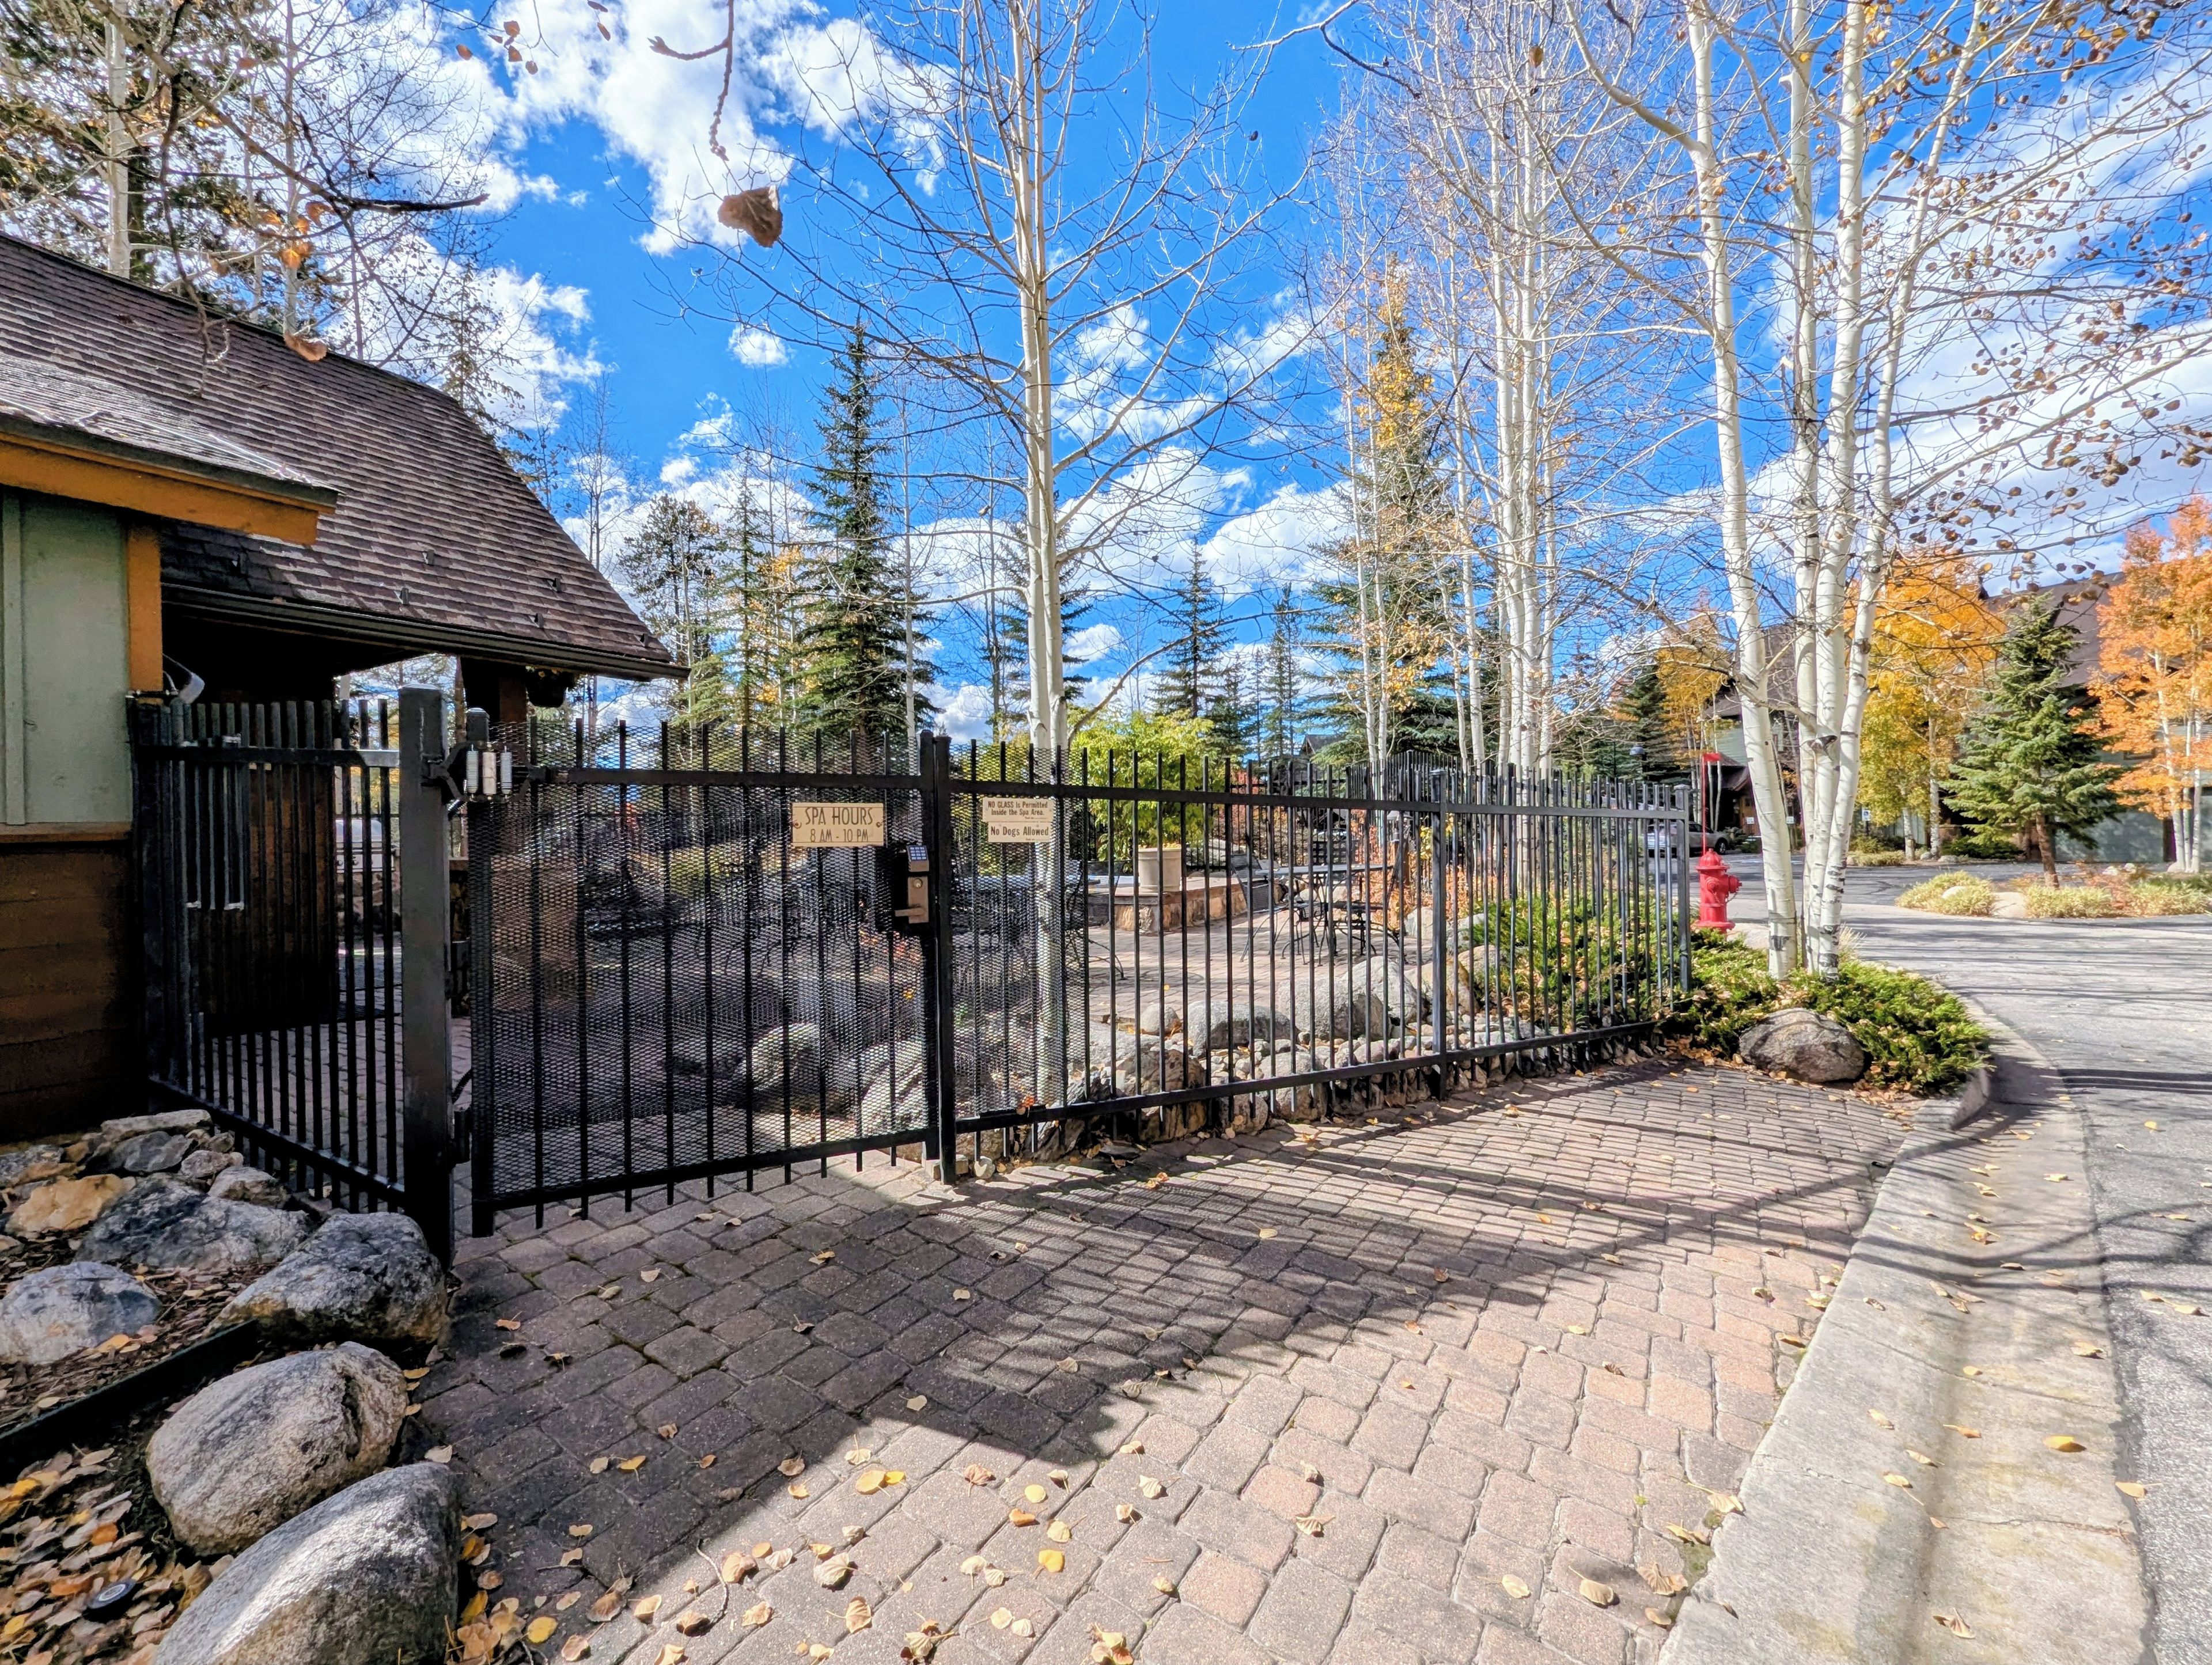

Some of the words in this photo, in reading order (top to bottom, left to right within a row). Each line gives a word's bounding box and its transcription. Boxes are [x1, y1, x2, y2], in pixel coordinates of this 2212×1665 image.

[805, 807, 826, 825] SPA
[832, 807, 873, 825] HOURS
[1019, 809, 1029, 817] Spa
[810, 829, 816, 842] 8
[820, 829, 832, 842] AM
[843, 829, 854, 842] 10
[857, 829, 869, 842] PM
[991, 826, 1000, 836] No
[1003, 826, 1020, 837] Dogs
[1023, 826, 1049, 836] Allowed
